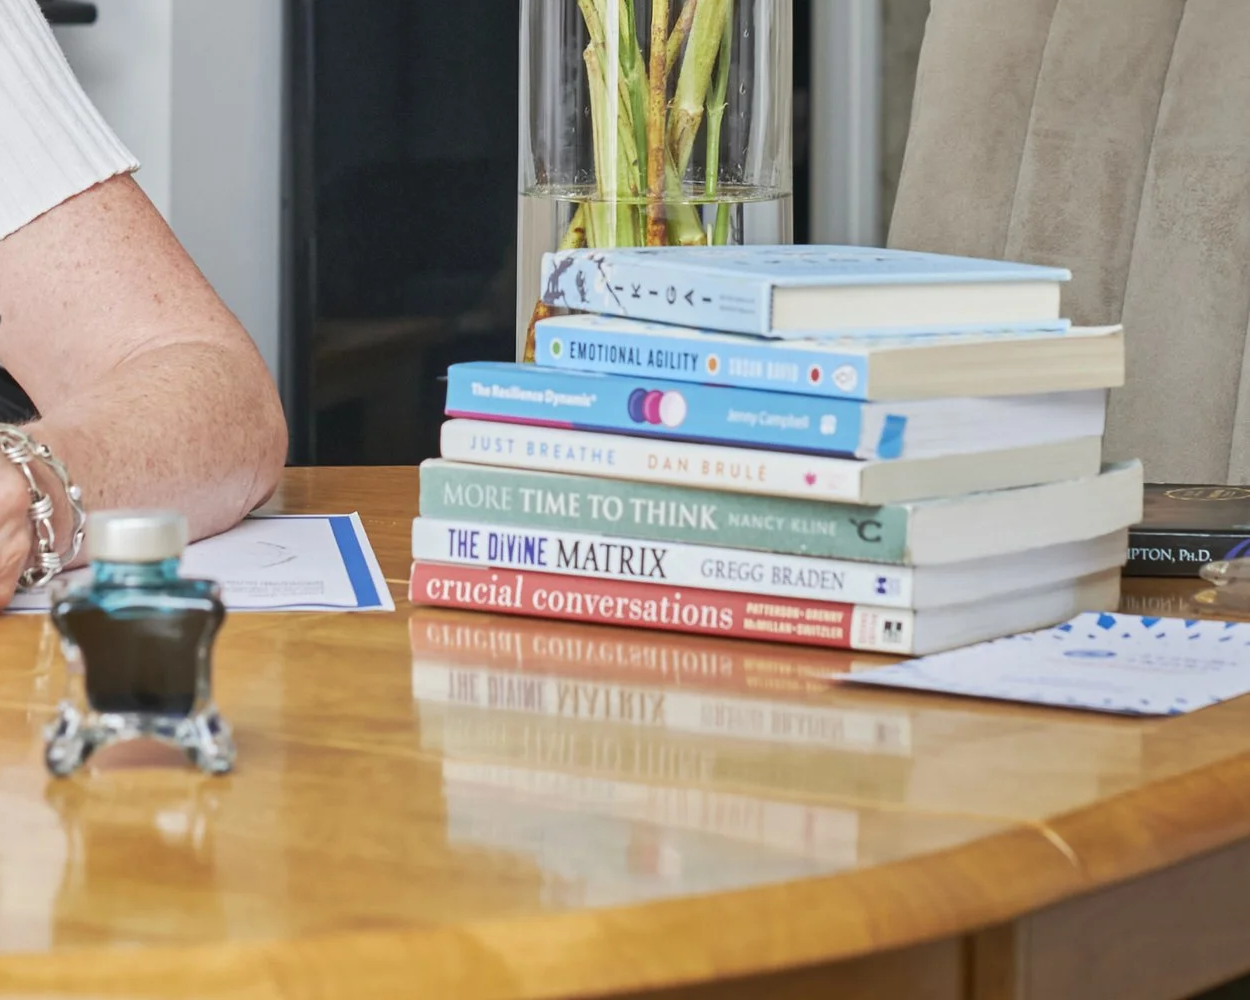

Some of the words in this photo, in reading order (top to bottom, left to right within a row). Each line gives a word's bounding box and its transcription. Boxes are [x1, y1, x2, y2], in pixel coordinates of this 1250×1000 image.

[569, 342, 642, 366] EMOTIONAL
[647, 350, 699, 372] AGILITY
[470, 381, 491, 398] The
[492, 384, 544, 403] Resilience
[726, 408, 757, 428] Jenny
[758, 410, 810, 430] Campbell
[470, 435, 515, 454] JUST
[526, 440, 617, 465] BREATHE
[647, 453, 689, 472] DAN
[442, 482, 512, 511] MORE
[518, 486, 581, 518] TIME
[587, 493, 624, 522] TO
[629, 498, 719, 531] THINK
[727, 512, 786, 532] NANCY
[790, 516, 838, 538] KLINE
[448, 527, 480, 560] THE
[556, 538, 669, 579] MATRIX
[700, 558, 765, 583] GREGG
[771, 564, 846, 590] BRADEN
[426, 573, 523, 609] crucial
[532, 586, 734, 631] conversations
